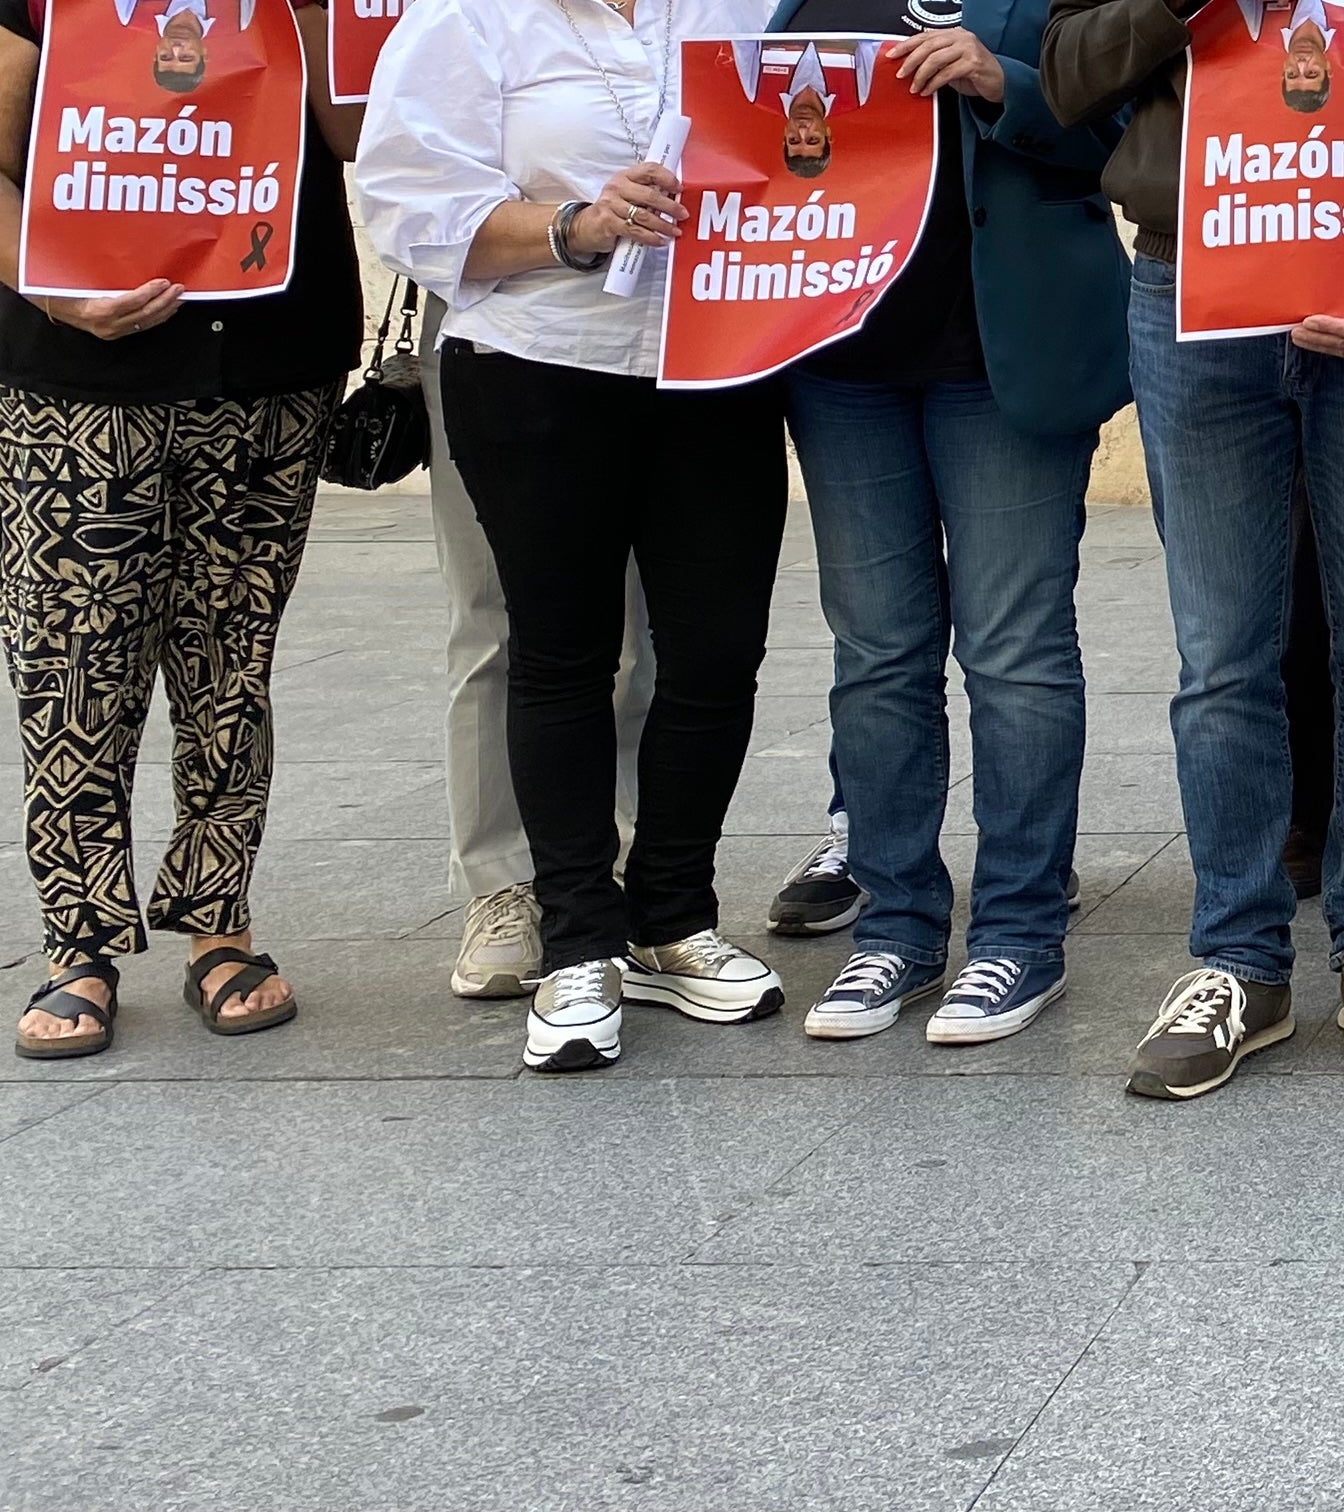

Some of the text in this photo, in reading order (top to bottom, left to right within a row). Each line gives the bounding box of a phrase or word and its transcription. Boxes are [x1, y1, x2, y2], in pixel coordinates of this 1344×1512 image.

[58, 106, 232, 157] Mazón
[53, 161, 279, 215] dimissió
[698, 190, 856, 242] Mazón
[692, 240, 895, 303] dimissió
